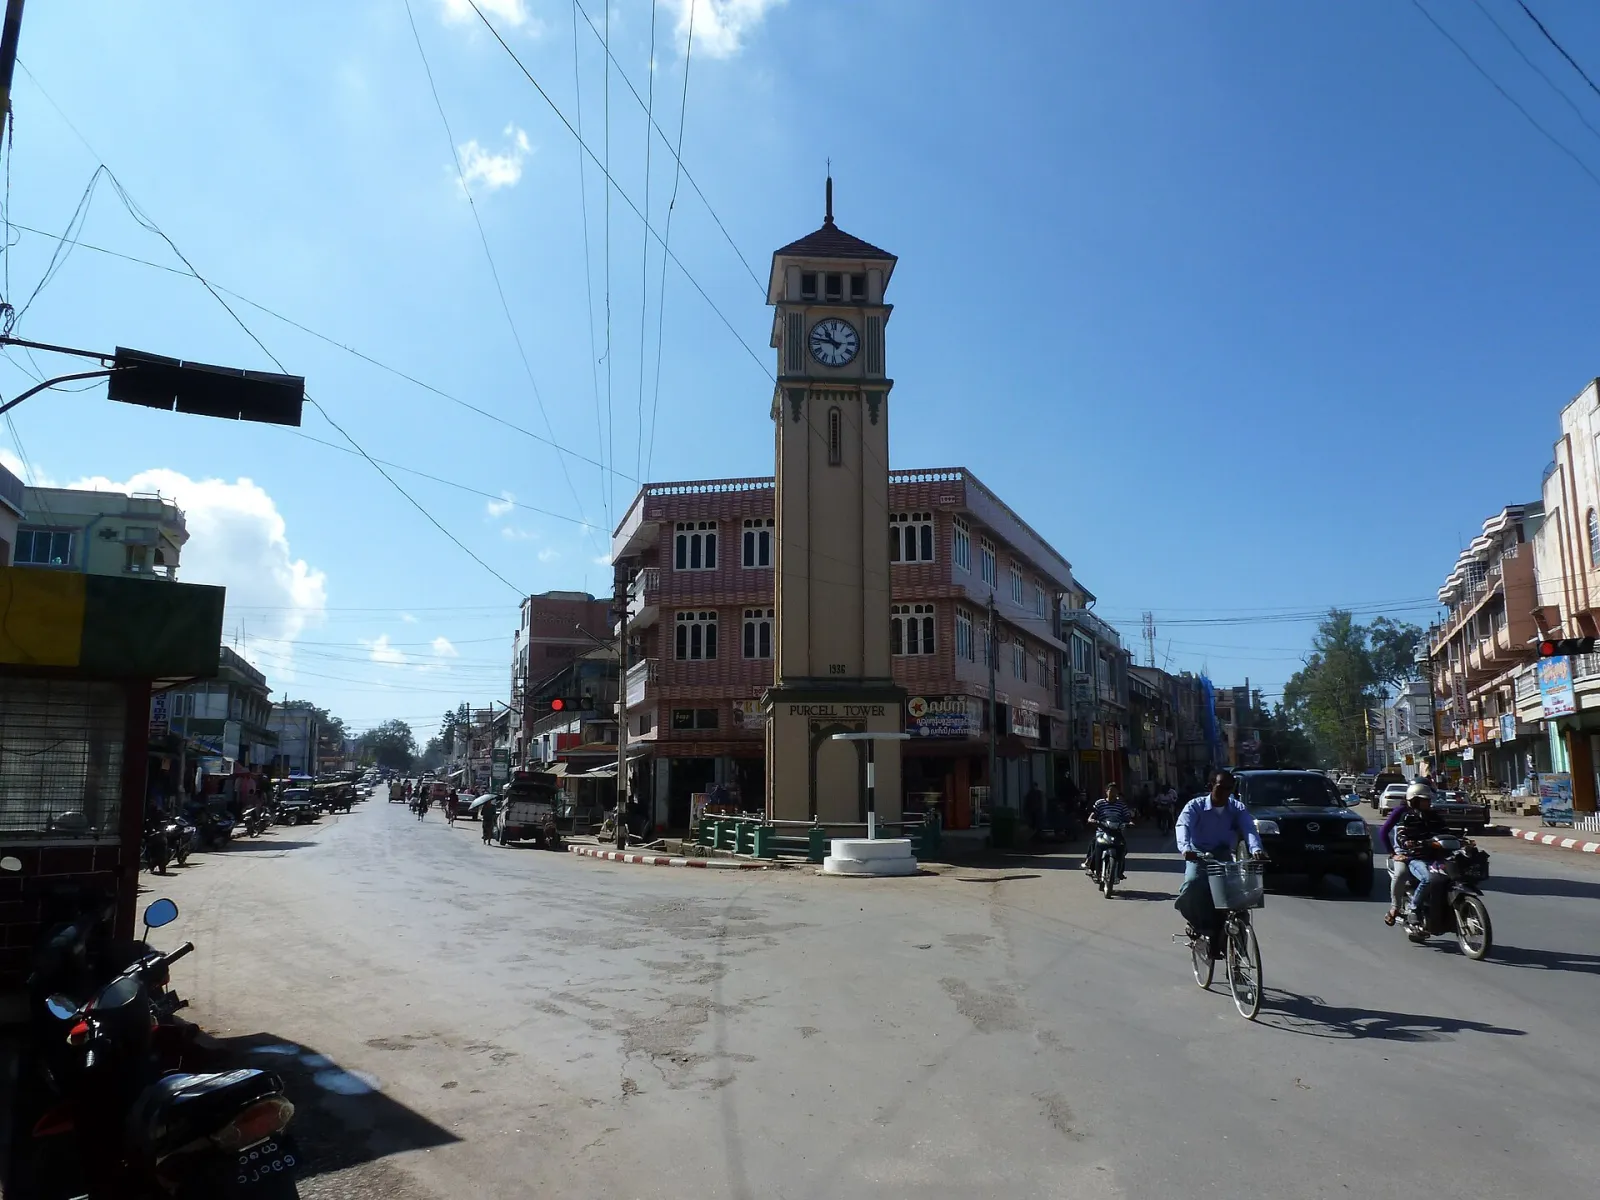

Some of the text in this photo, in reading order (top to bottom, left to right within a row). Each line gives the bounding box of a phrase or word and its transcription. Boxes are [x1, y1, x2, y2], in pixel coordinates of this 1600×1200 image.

[828, 664, 846, 674] 1936
[789, 705, 885, 716] PURCELL TOWER
